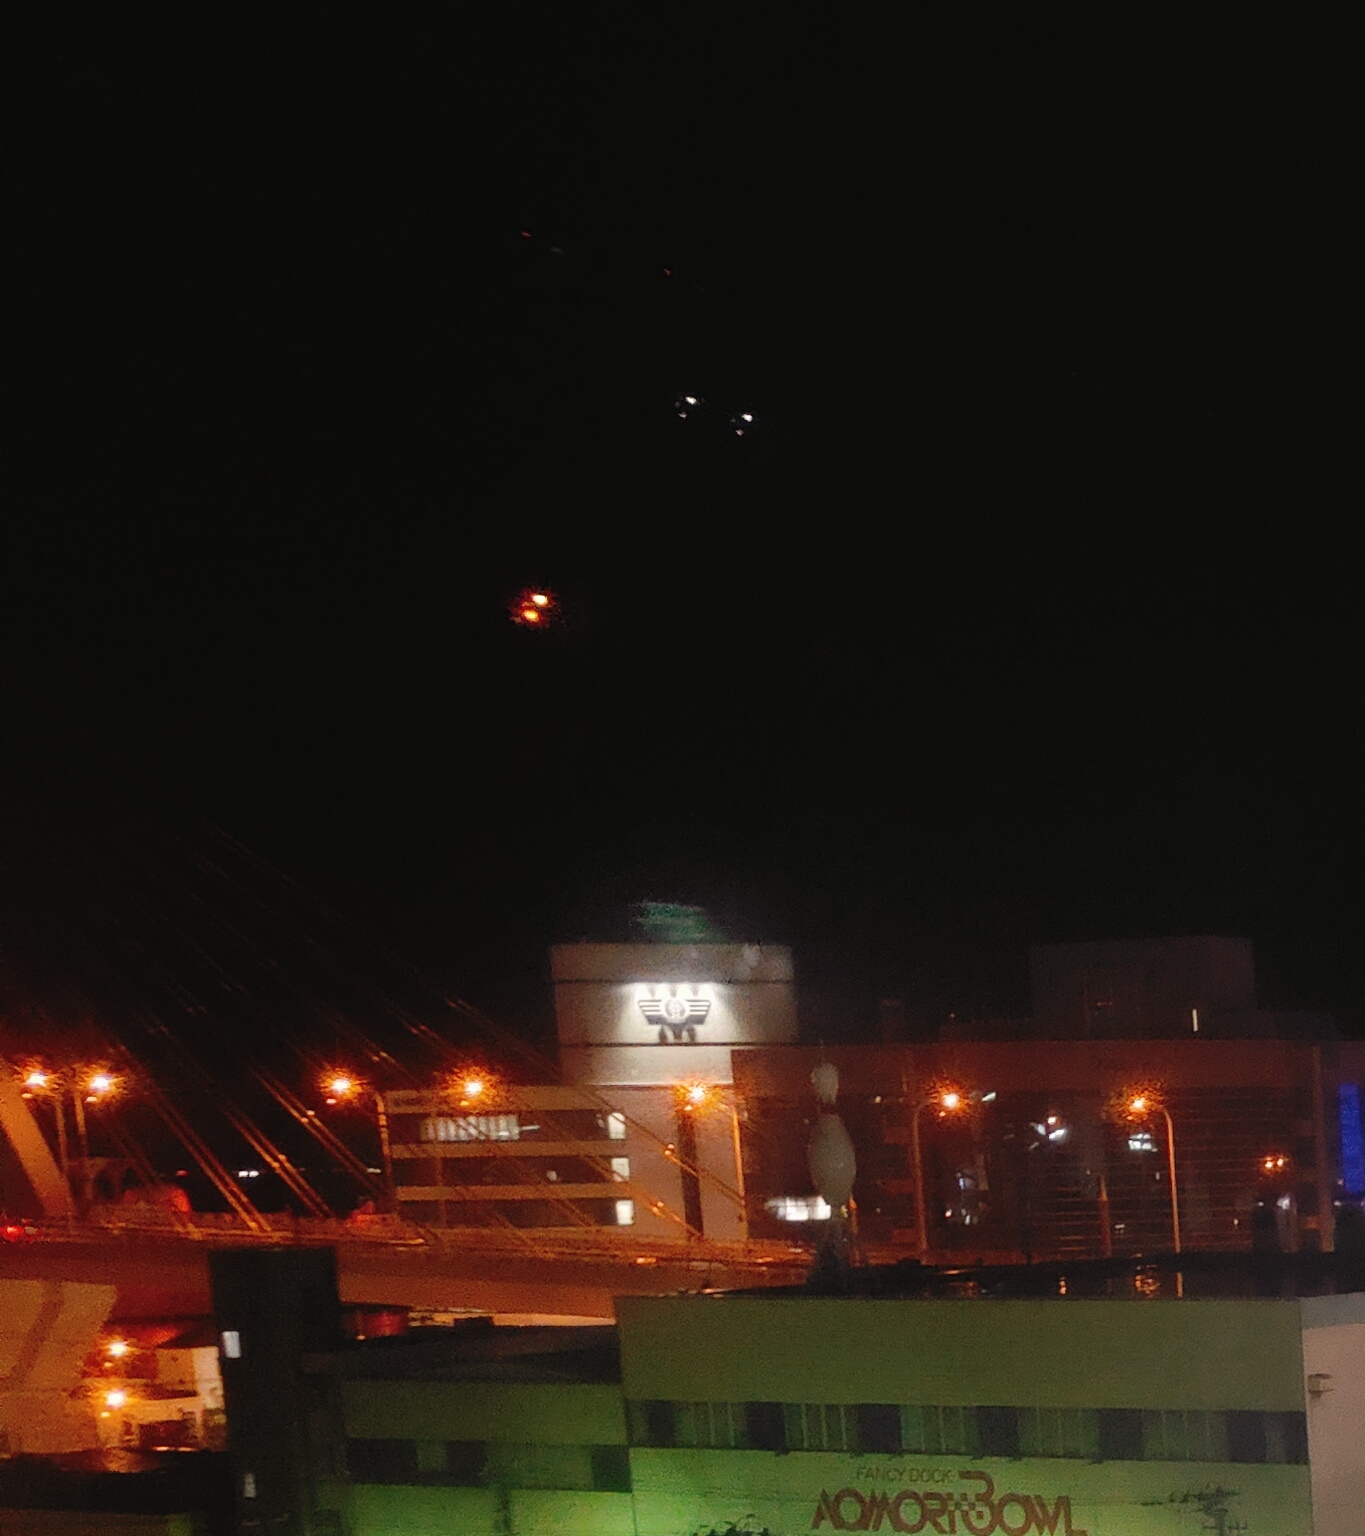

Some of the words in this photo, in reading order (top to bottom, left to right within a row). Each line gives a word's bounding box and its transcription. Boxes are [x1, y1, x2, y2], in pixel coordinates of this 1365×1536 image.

[856, 1466, 904, 1483] FANCY
[908, 1468, 951, 1484] DOCK
[811, 1486, 956, 1535] AOMORI
